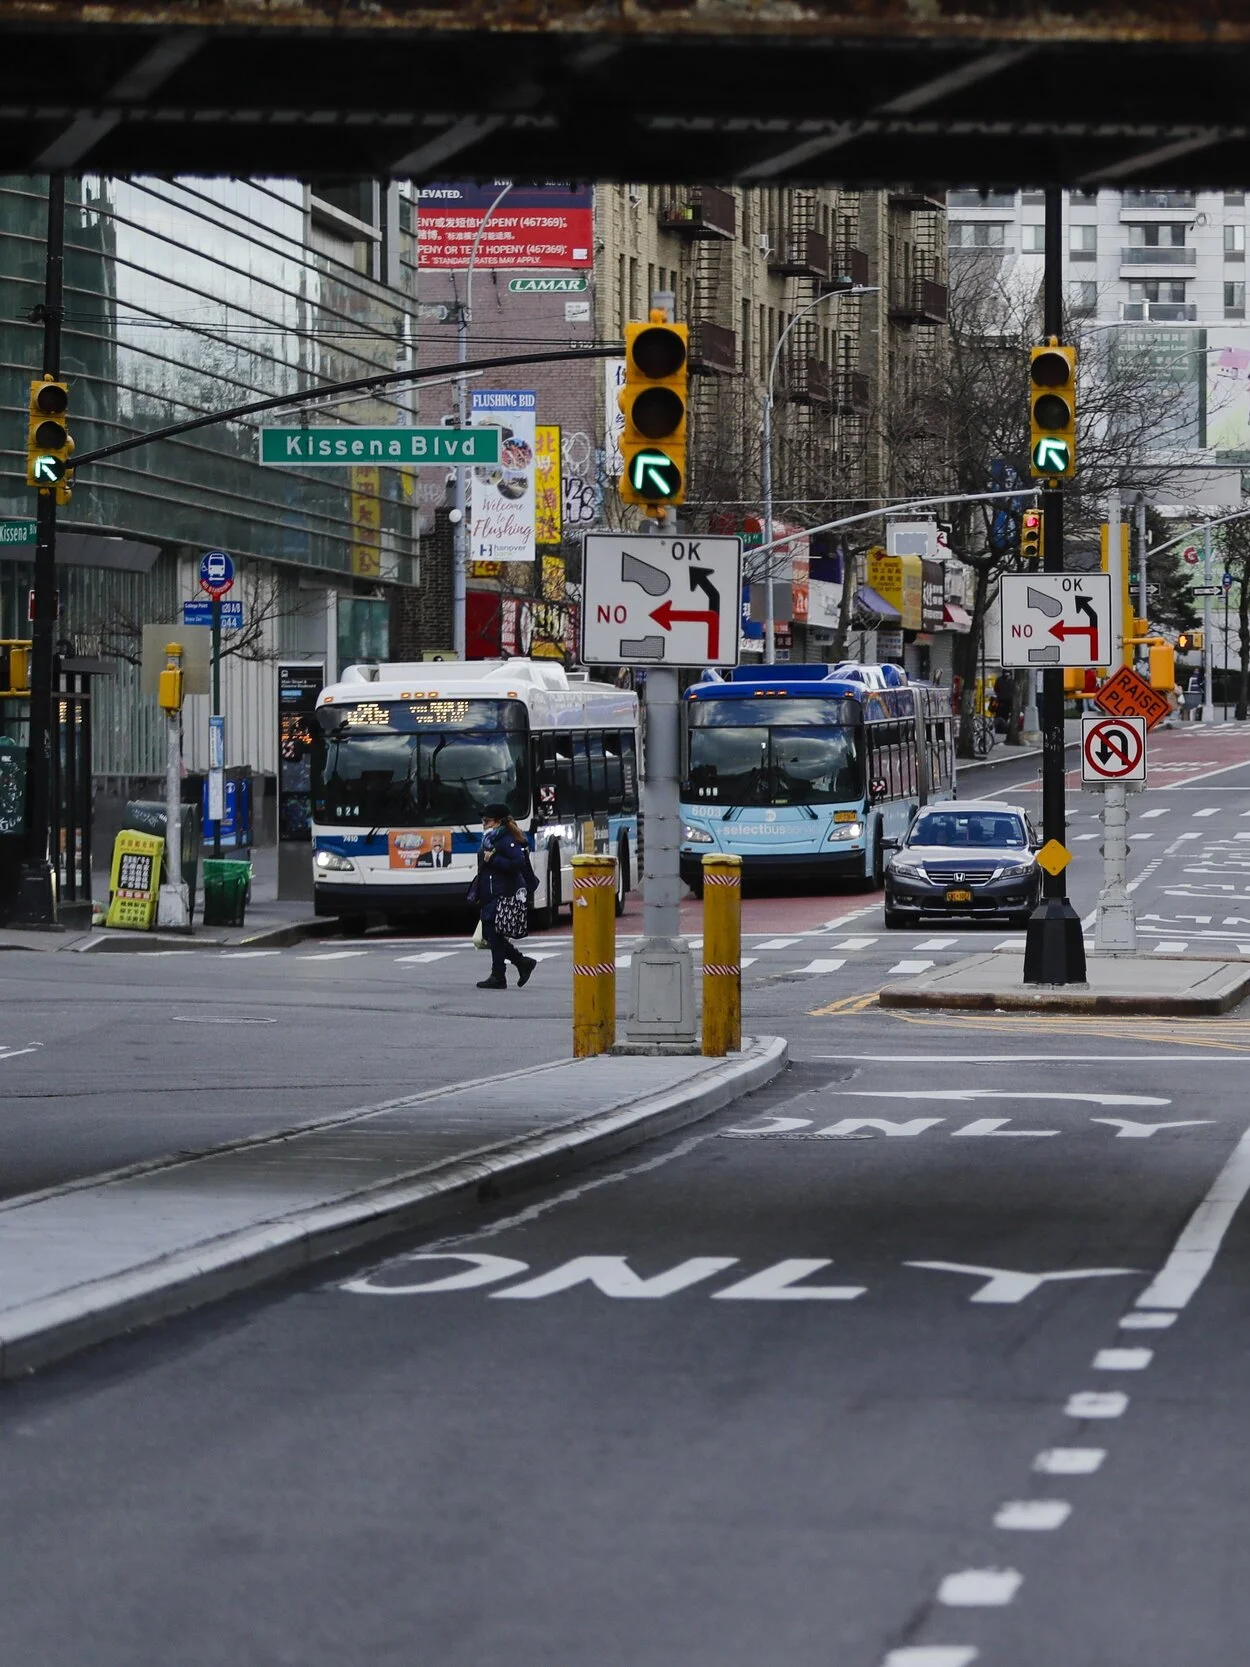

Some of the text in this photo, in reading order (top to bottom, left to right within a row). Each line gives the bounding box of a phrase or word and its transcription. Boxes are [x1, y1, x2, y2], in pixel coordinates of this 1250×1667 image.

[417, 189, 463, 199] LEVATED.
[418, 245, 443, 254] PENY
[444, 245, 458, 254] OR
[486, 245, 526, 254] HOPENY
[515, 279, 581, 290] LAMAR
[473, 394, 535, 407] FLUSHING BID
[286, 436, 475, 456] Kissena Blvd
[483, 499, 527, 511] Welcome
[473, 514, 535, 544] Flushing
[672, 543, 701, 560] OK
[1062, 578, 1083, 592] OK
[597, 605, 627, 623] NO
[1011, 624, 1033, 638] NO
[1105, 690, 1140, 716] PLO
[1117, 675, 1161, 716] RAISE
[691, 807, 721, 817] 6003
[726, 1116, 1217, 1138] ONLY
[338, 1253, 1145, 1303] ONLY
